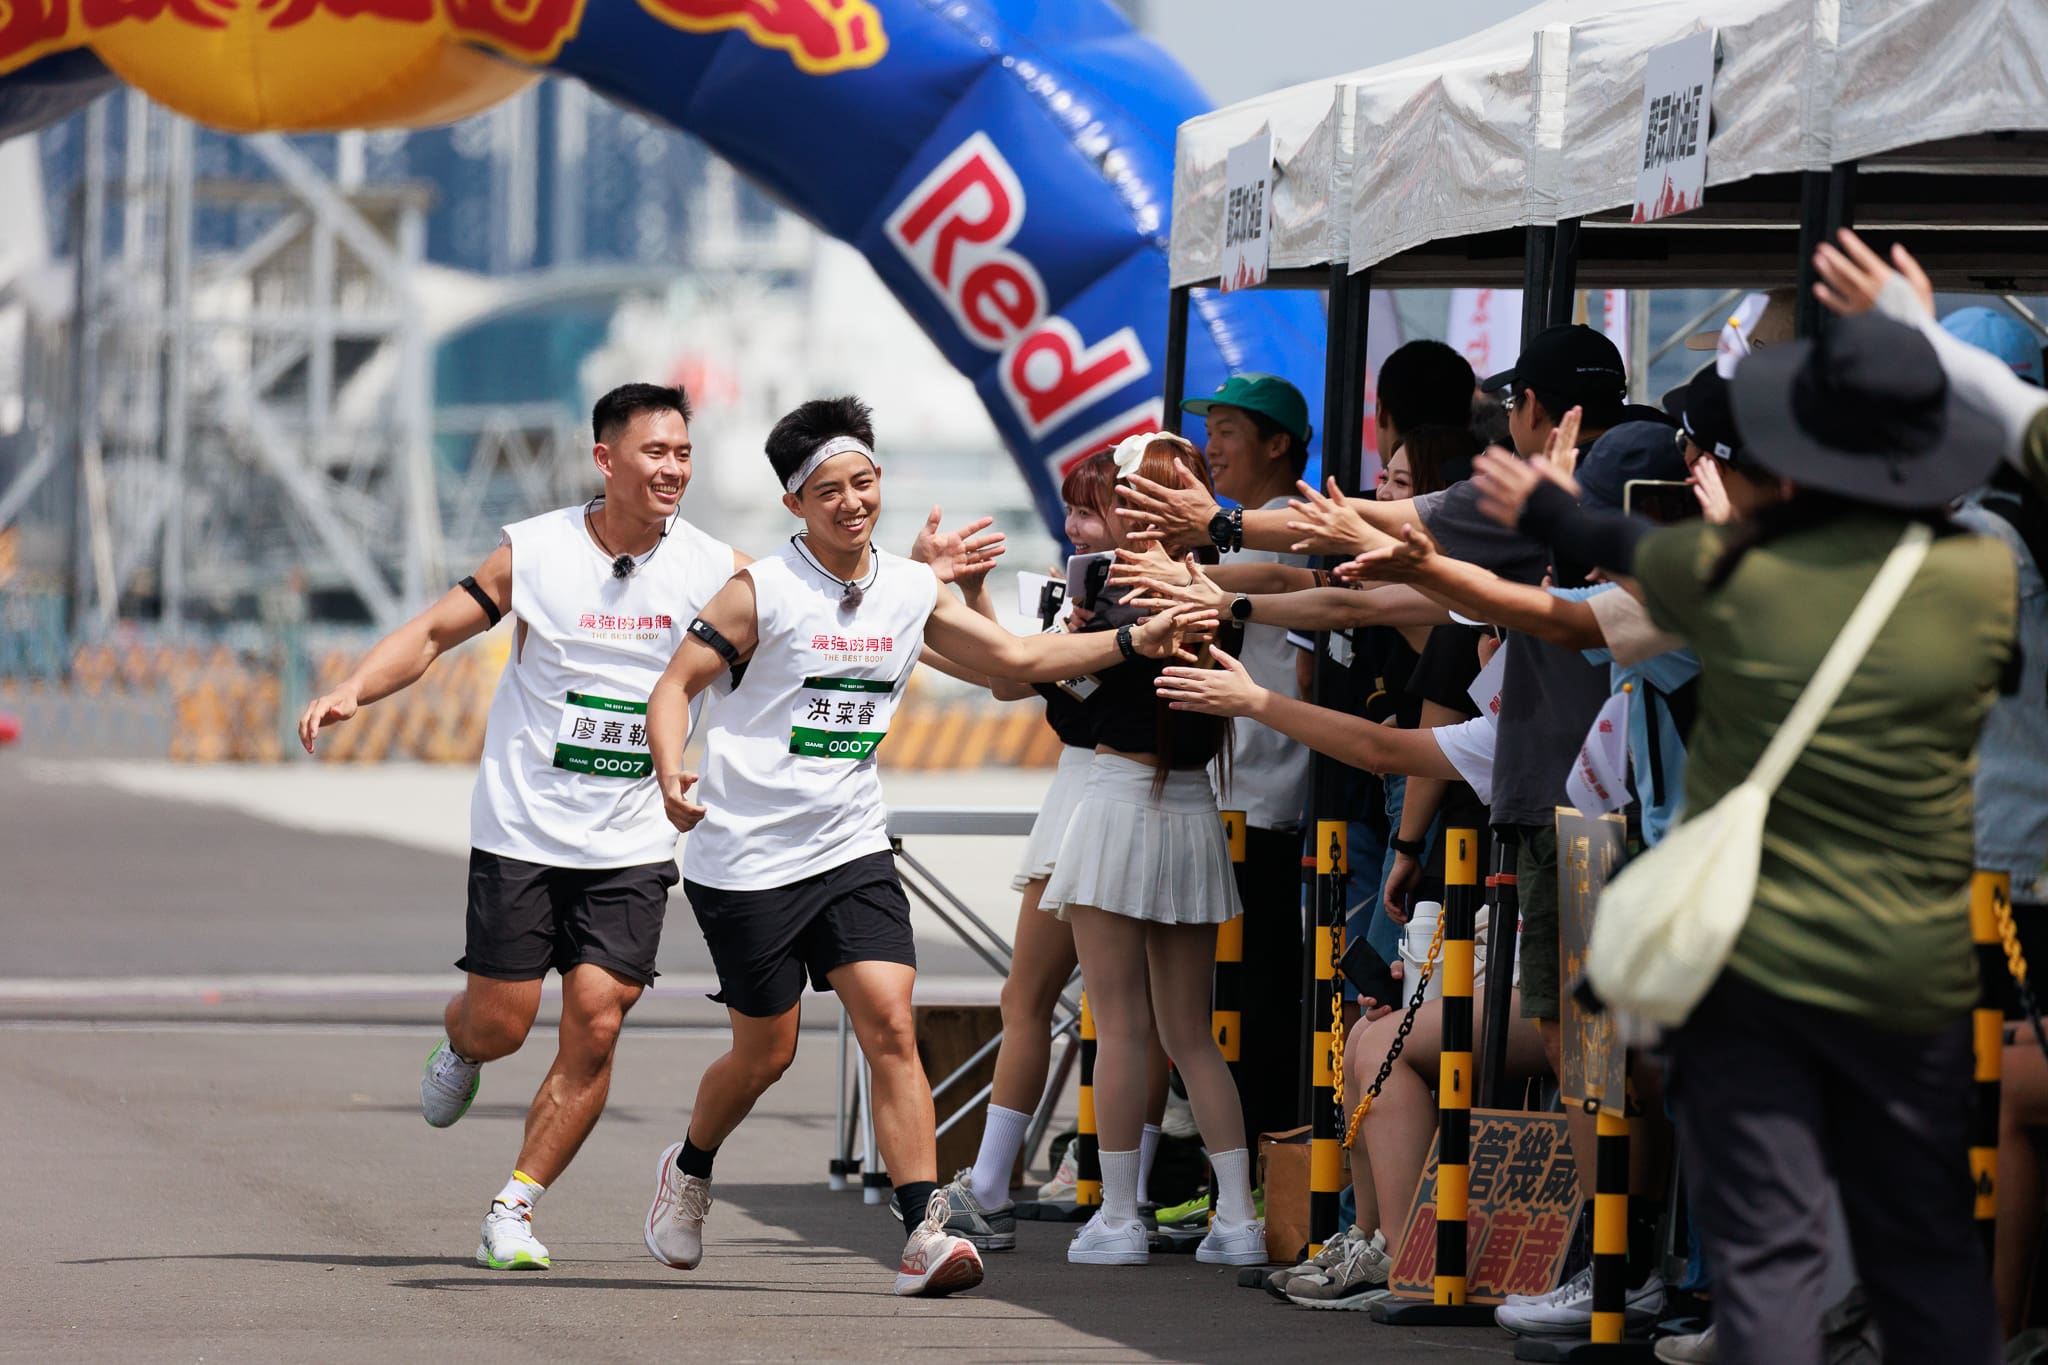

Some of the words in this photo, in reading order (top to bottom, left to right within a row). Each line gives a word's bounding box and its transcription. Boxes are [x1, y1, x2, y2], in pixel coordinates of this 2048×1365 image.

[890, 140, 1142, 434] Red
[592, 631, 606, 640] THE
[611, 632, 632, 641] BEST
[635, 632, 660, 641] BODY
[823, 653, 839, 662] THE
[842, 654, 862, 663] BEST
[864, 655, 884, 664] BODY
[804, 741, 824, 749] GAME
[828, 740, 875, 753] 0007
[568, 757, 589, 766] GAME
[593, 757, 645, 774] 0007
[1427, 1121, 1580, 1209] 管幾歲
